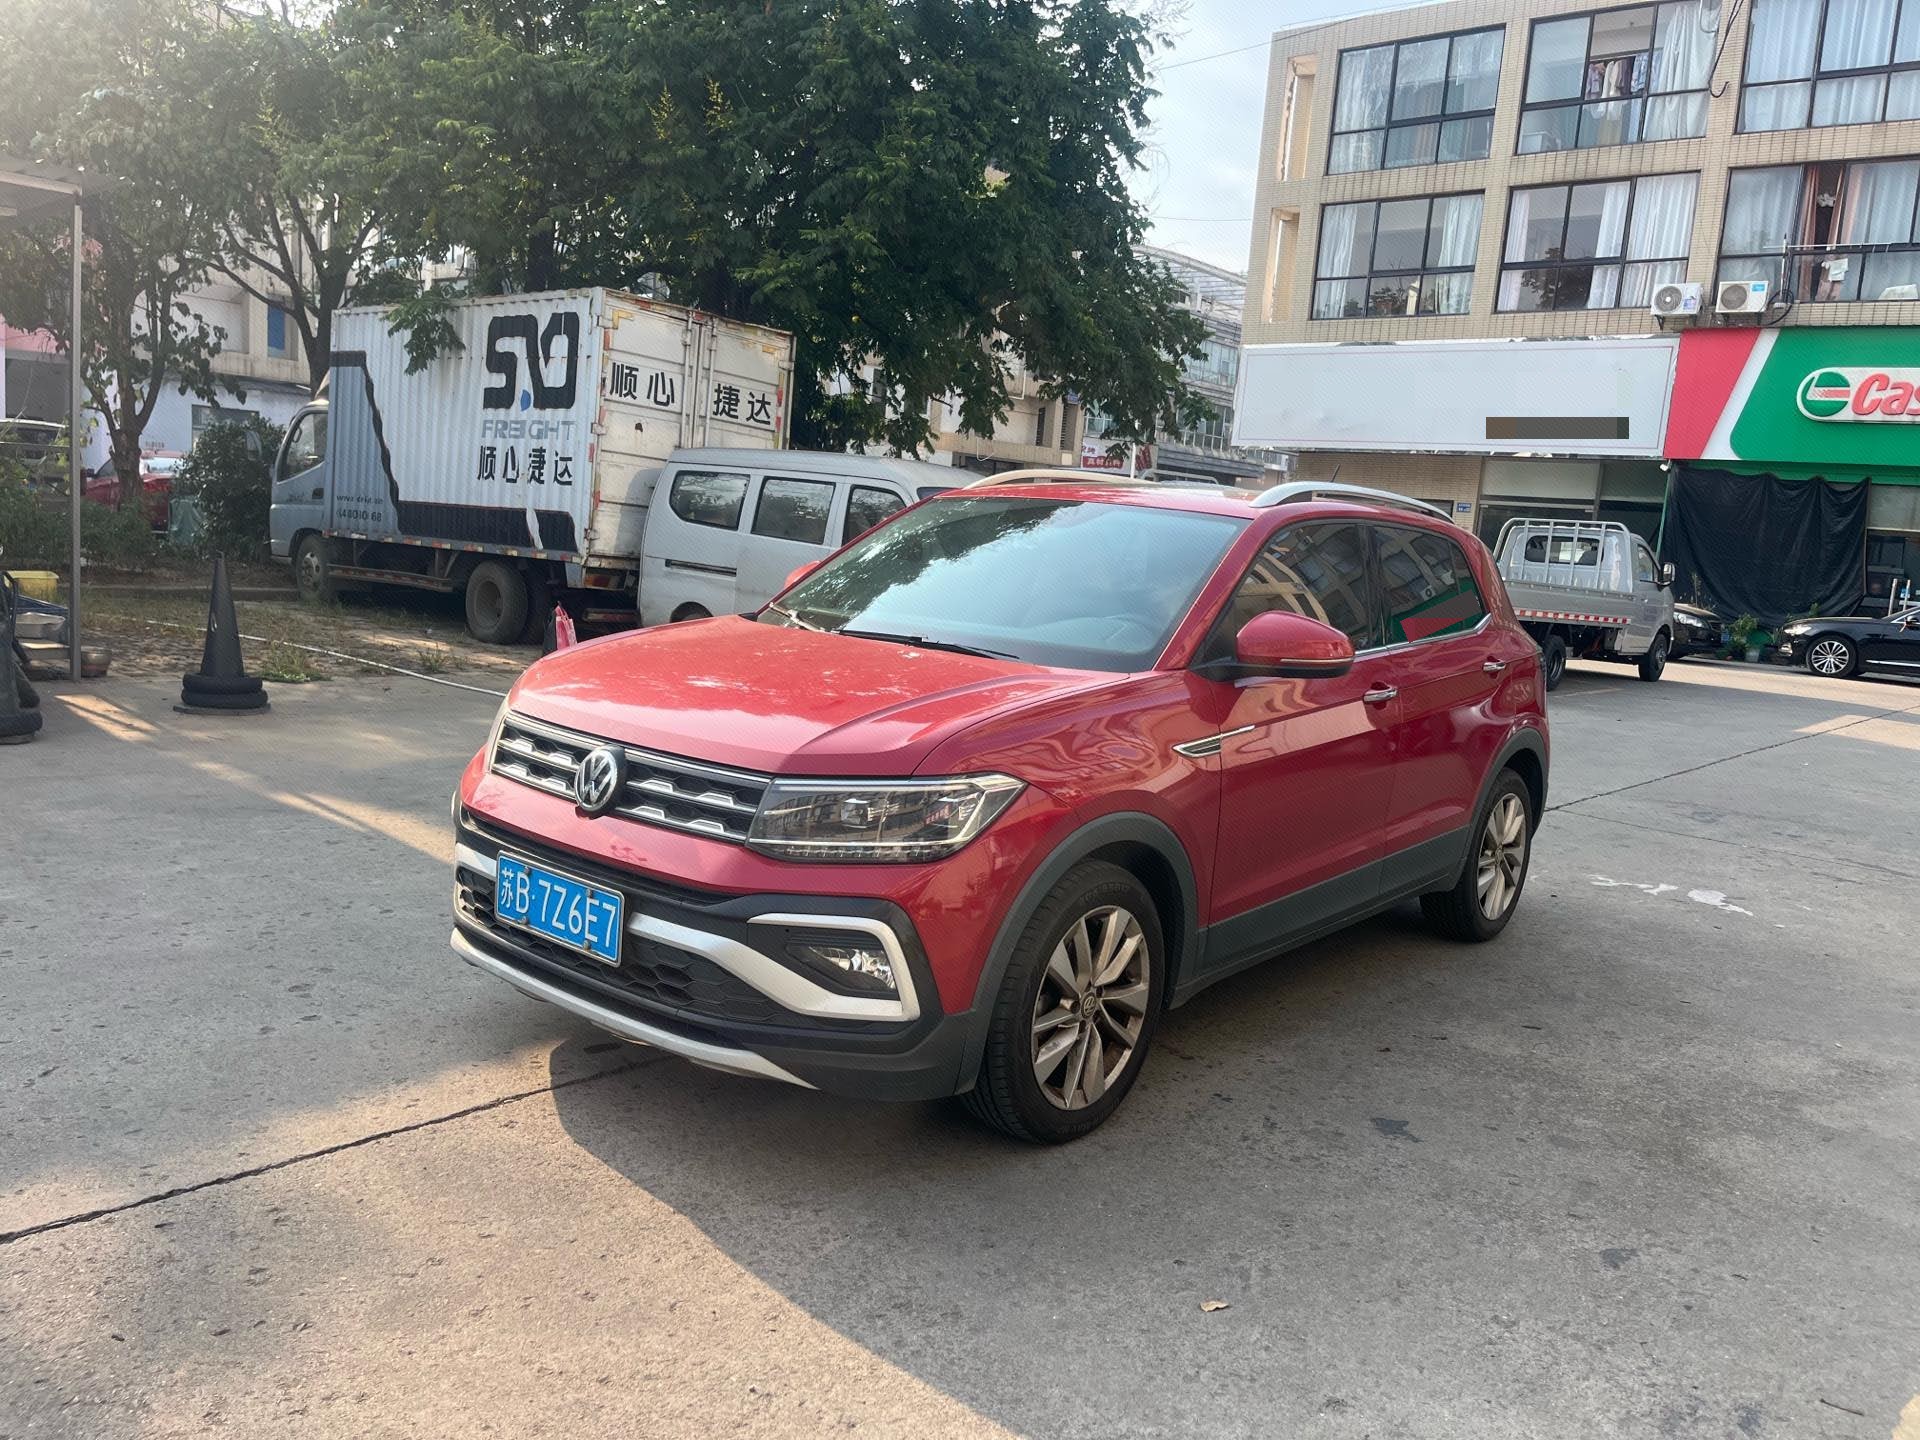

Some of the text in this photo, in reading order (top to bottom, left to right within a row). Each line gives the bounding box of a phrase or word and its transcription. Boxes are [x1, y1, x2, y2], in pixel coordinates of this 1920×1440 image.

[481, 420, 577, 440] FREIGHT
[477, 445, 573, 485] 顺心捷达
